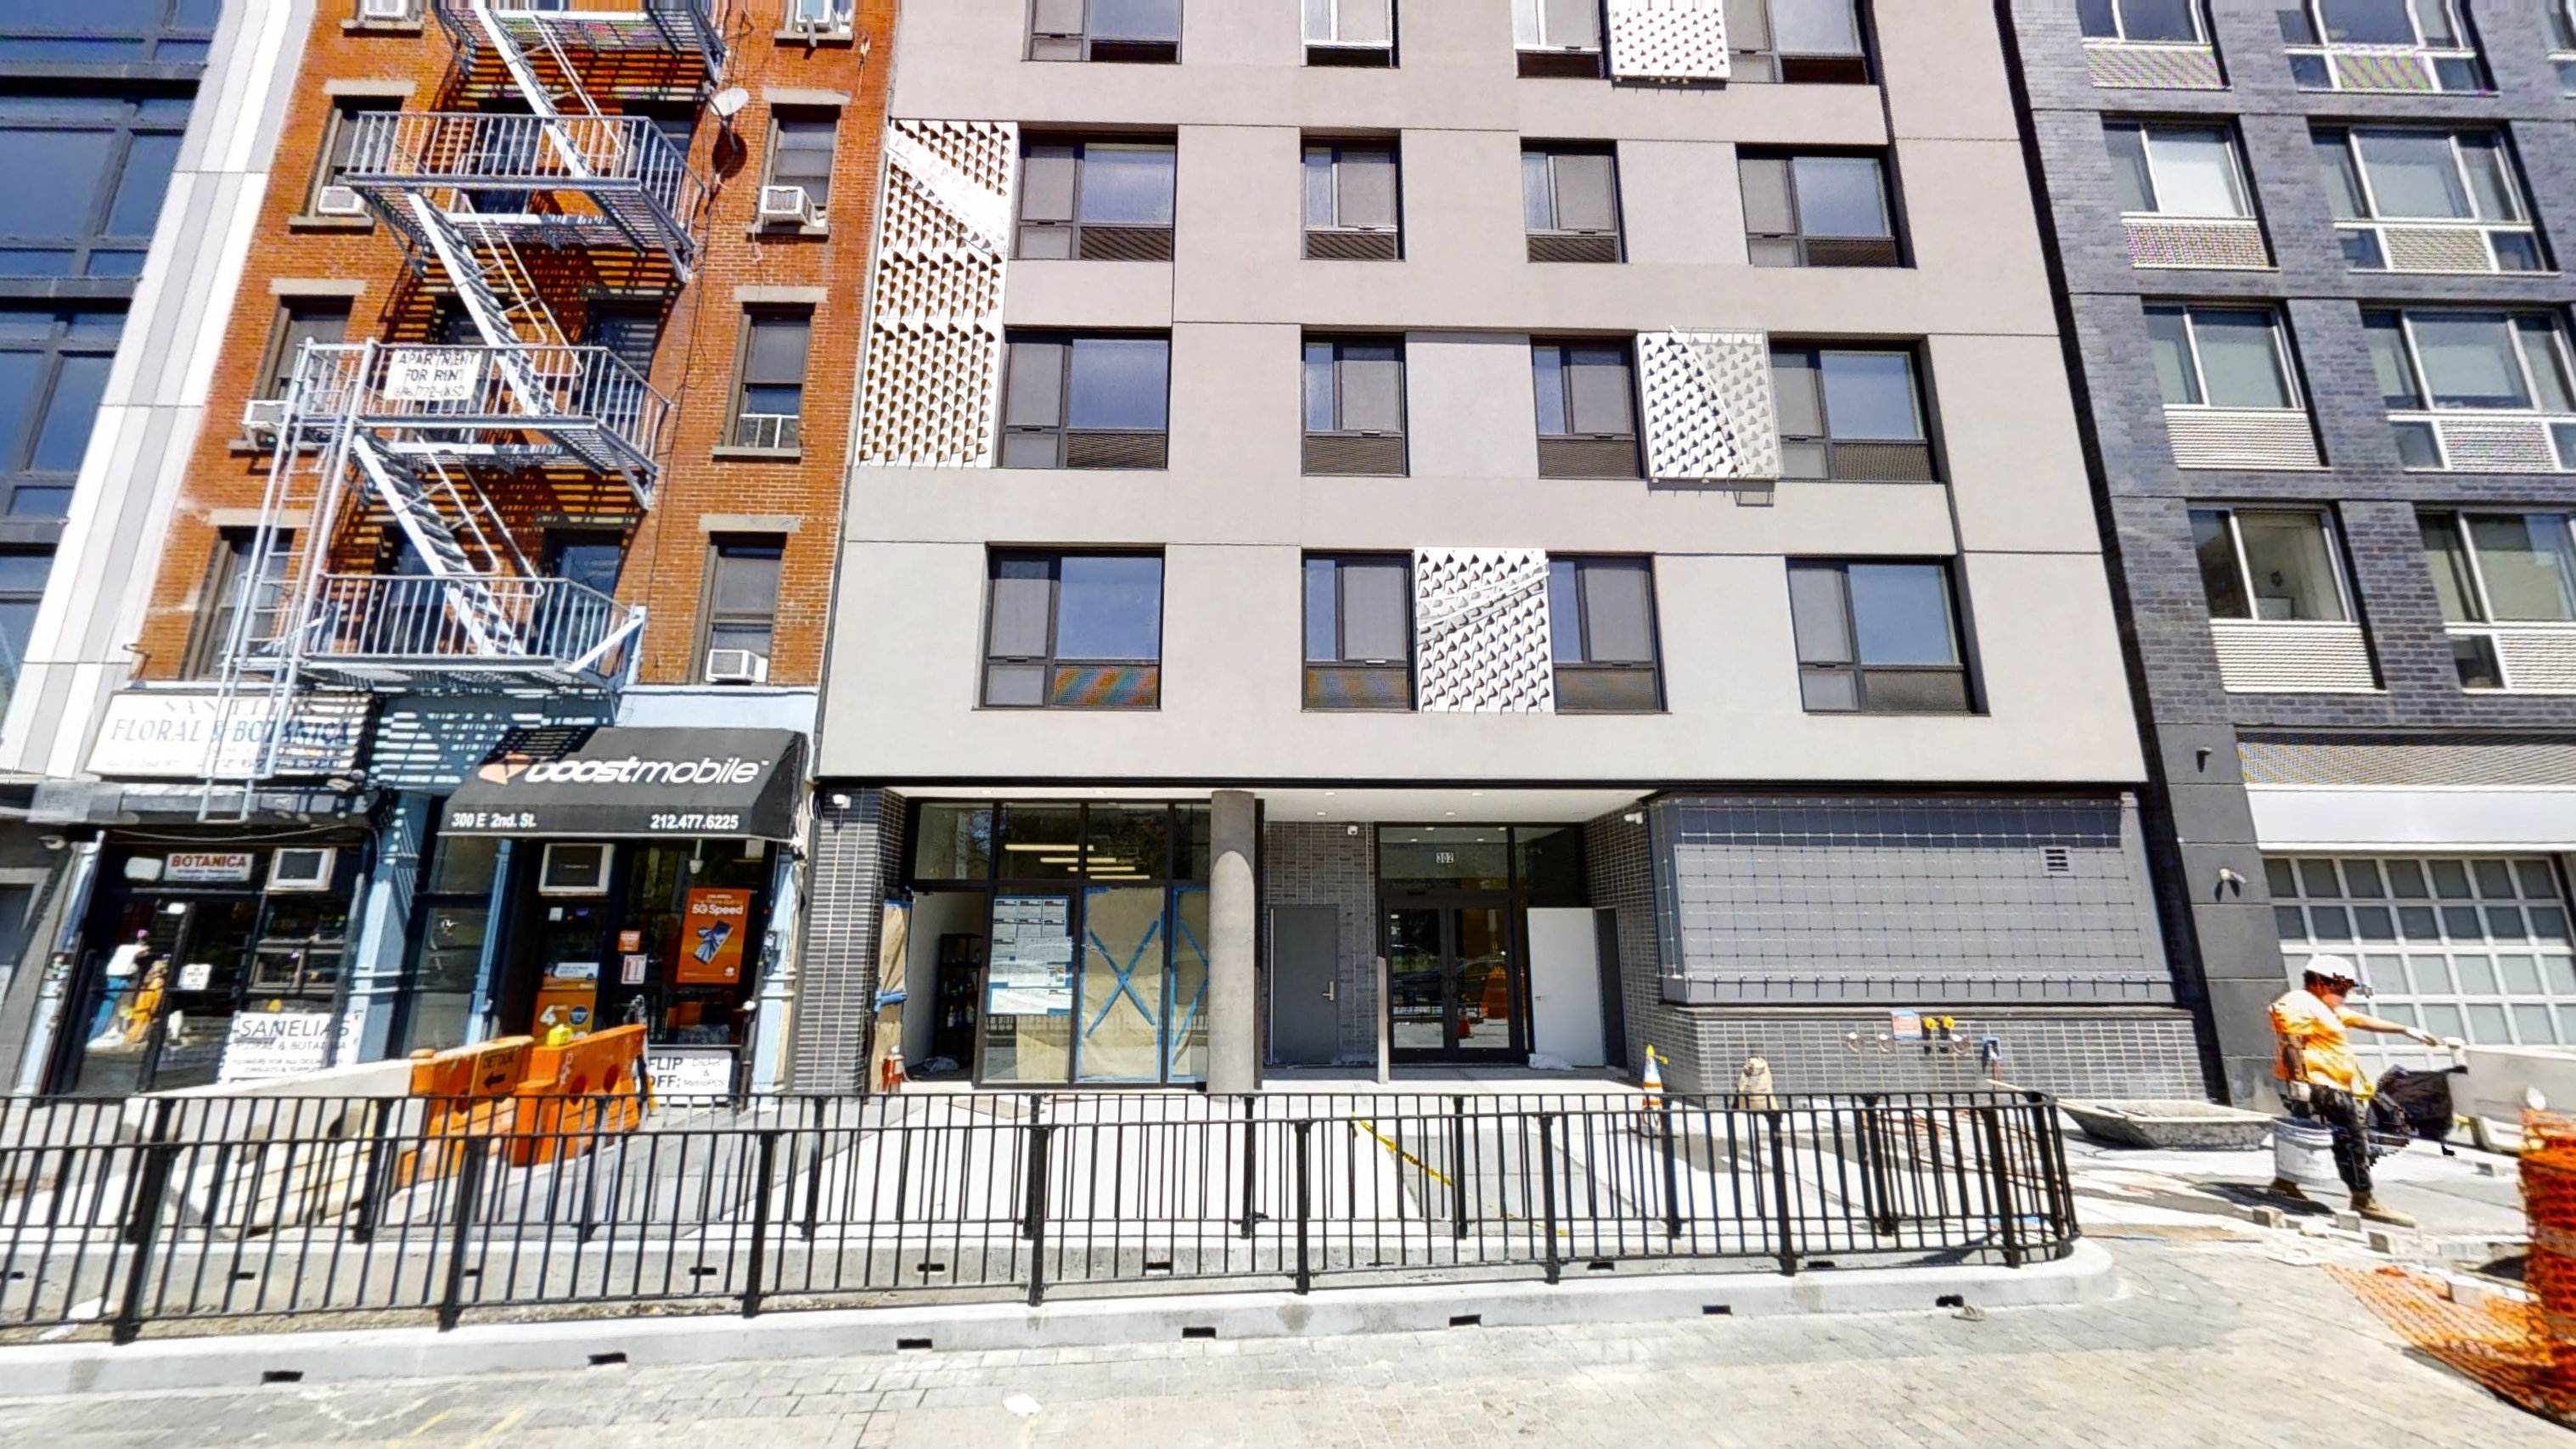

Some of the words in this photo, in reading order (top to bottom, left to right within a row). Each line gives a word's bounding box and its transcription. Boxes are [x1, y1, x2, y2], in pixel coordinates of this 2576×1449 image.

[110, 720, 201, 742] FLORAL
[451, 813, 474, 828] 300
[475, 814, 485, 828] E
[650, 814, 740, 830] 212.477.6225
[172, 855, 247, 868] BOTANICA
[1436, 852, 1454, 863] 302
[708, 903, 744, 917] Speed
[648, 1057, 683, 1070] FLIP
